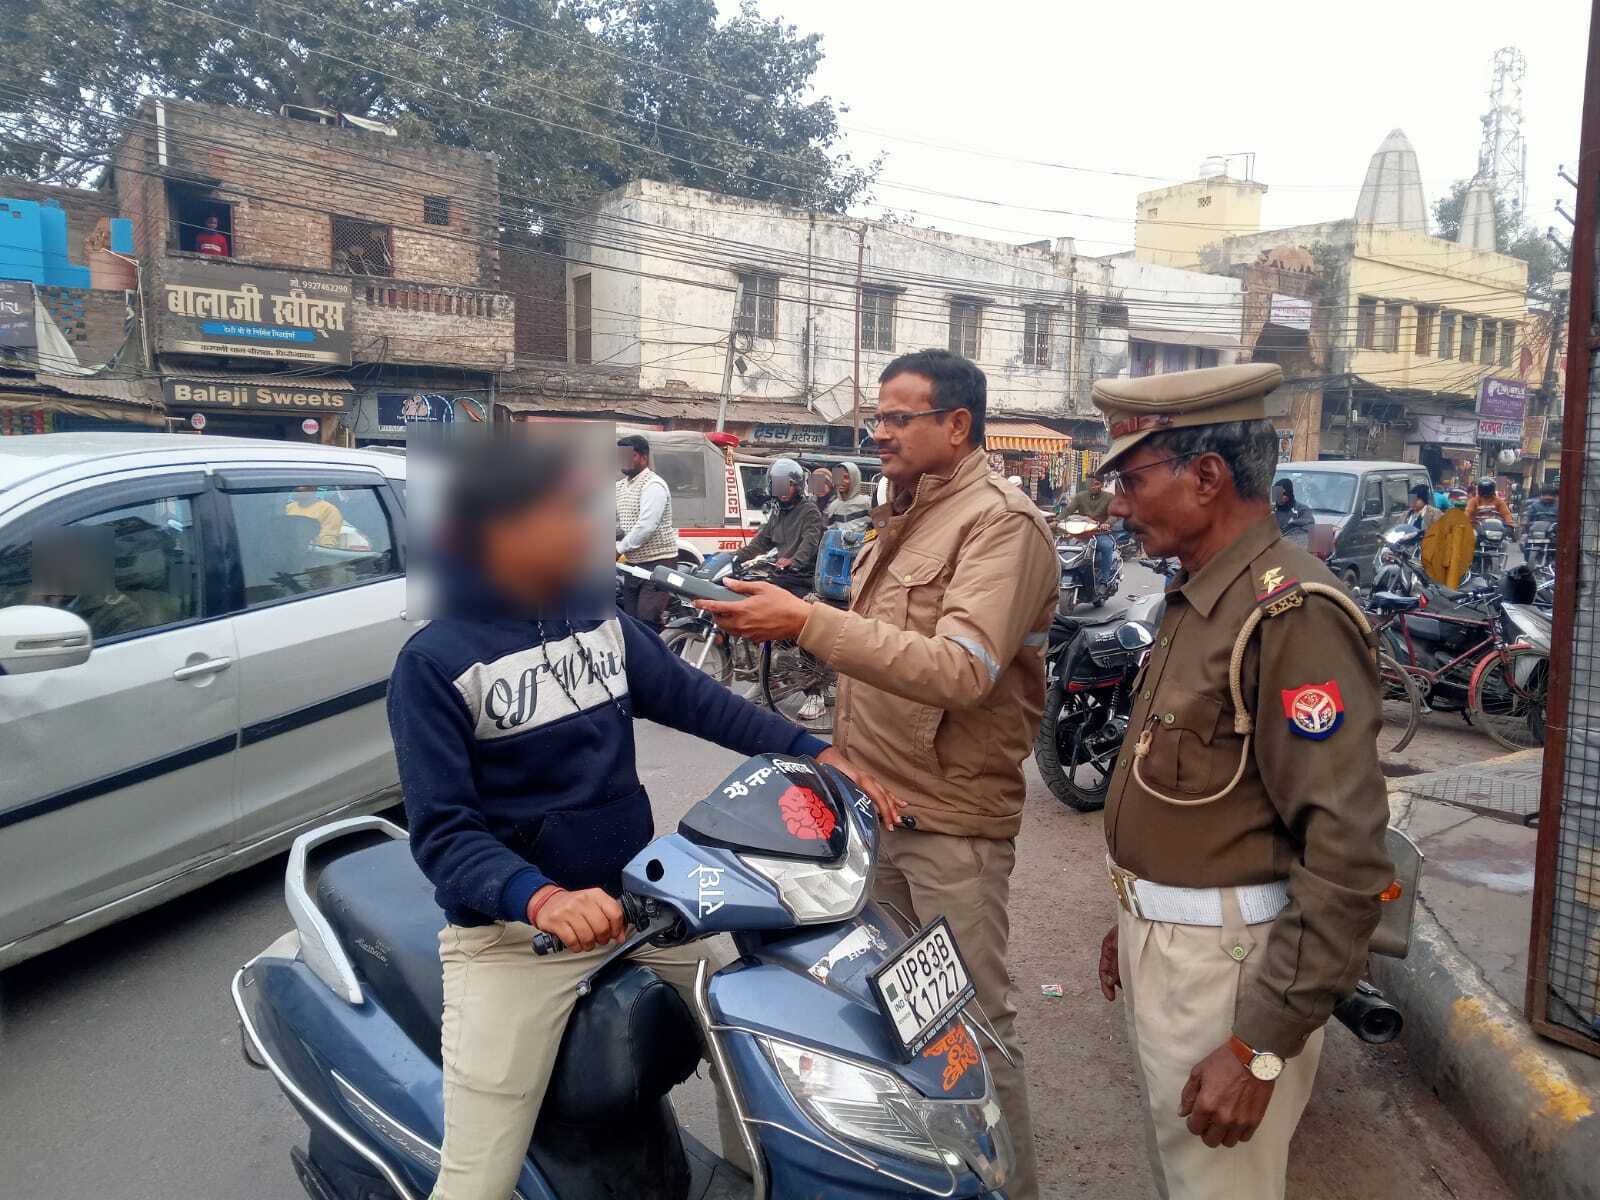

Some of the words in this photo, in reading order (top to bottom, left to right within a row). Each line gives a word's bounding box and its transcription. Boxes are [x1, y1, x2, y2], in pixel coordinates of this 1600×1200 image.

[165, 283, 263, 322] बालाजी
[271, 288, 346, 338] स्वीट्स
[174, 384, 248, 407] Balaji
[256, 388, 344, 408] Sweets
[725, 467, 738, 514] POLICE
[485, 663, 550, 730] Off
[553, 647, 626, 691] Whit
[687, 863, 725, 918] राधे
[895, 933, 950, 994] UP83B
[907, 961, 960, 1028] K1727
